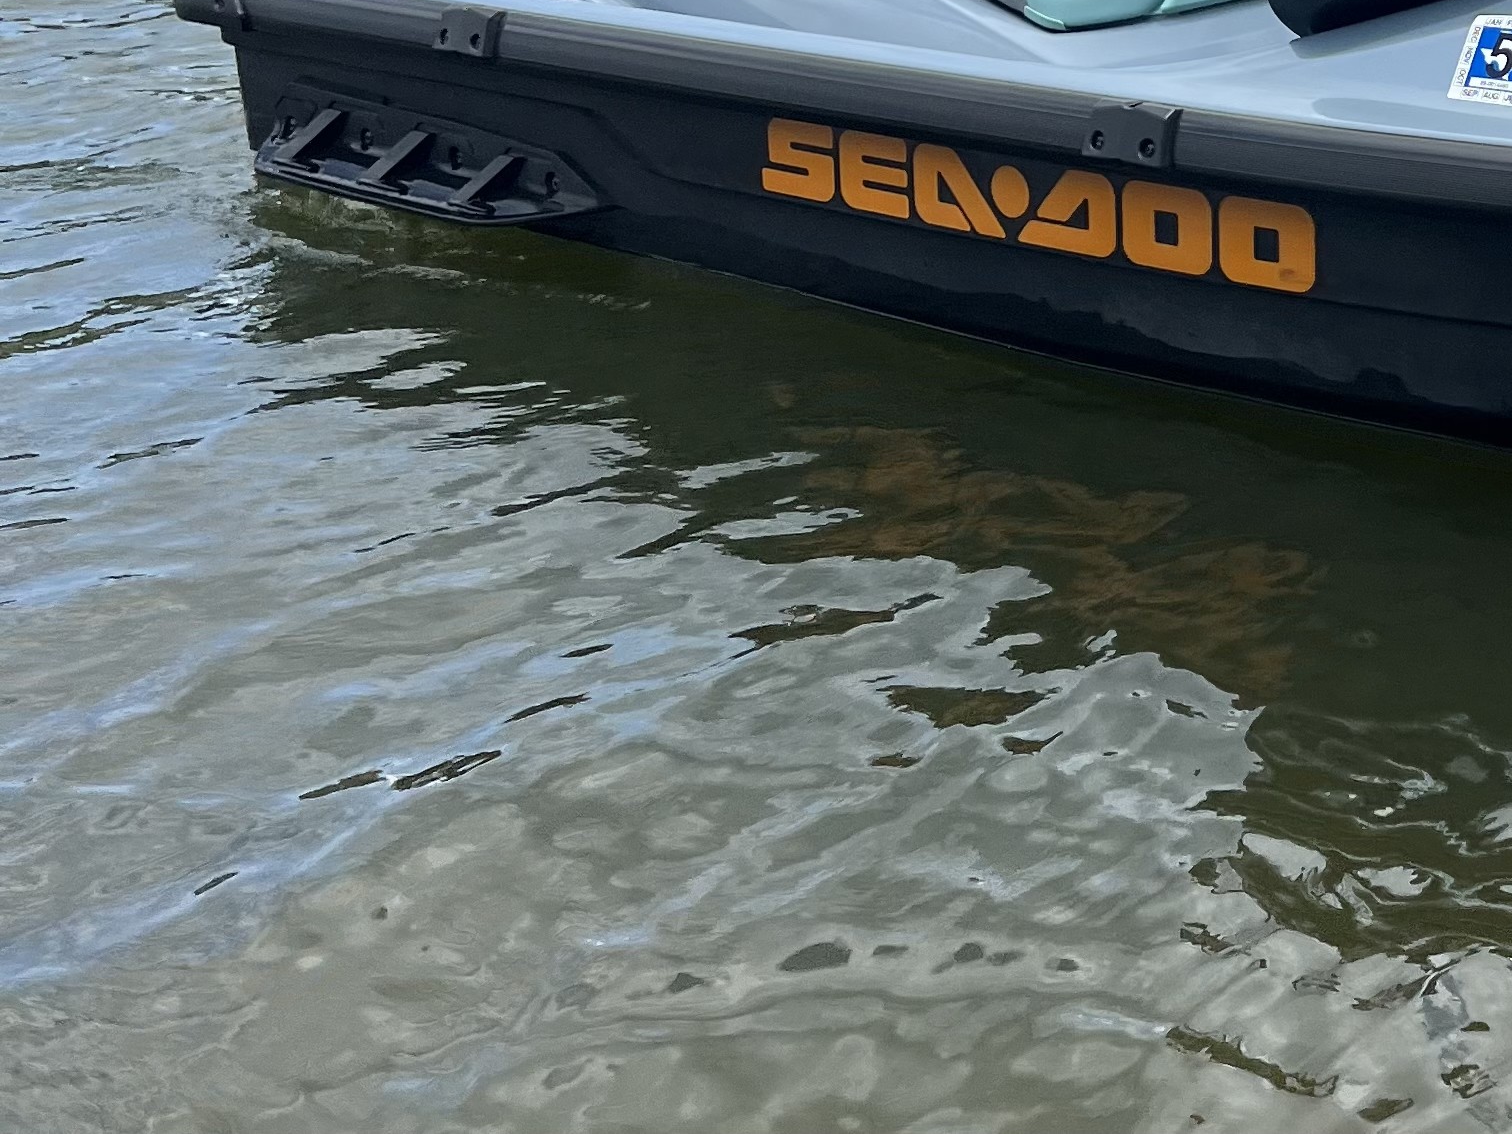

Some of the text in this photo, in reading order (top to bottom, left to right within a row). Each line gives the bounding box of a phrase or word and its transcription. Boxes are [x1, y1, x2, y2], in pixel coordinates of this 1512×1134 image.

[1486, 18, 1503, 26] JAN
[1456, 69, 1467, 85] OCT
[1463, 88, 1479, 97] SEP
